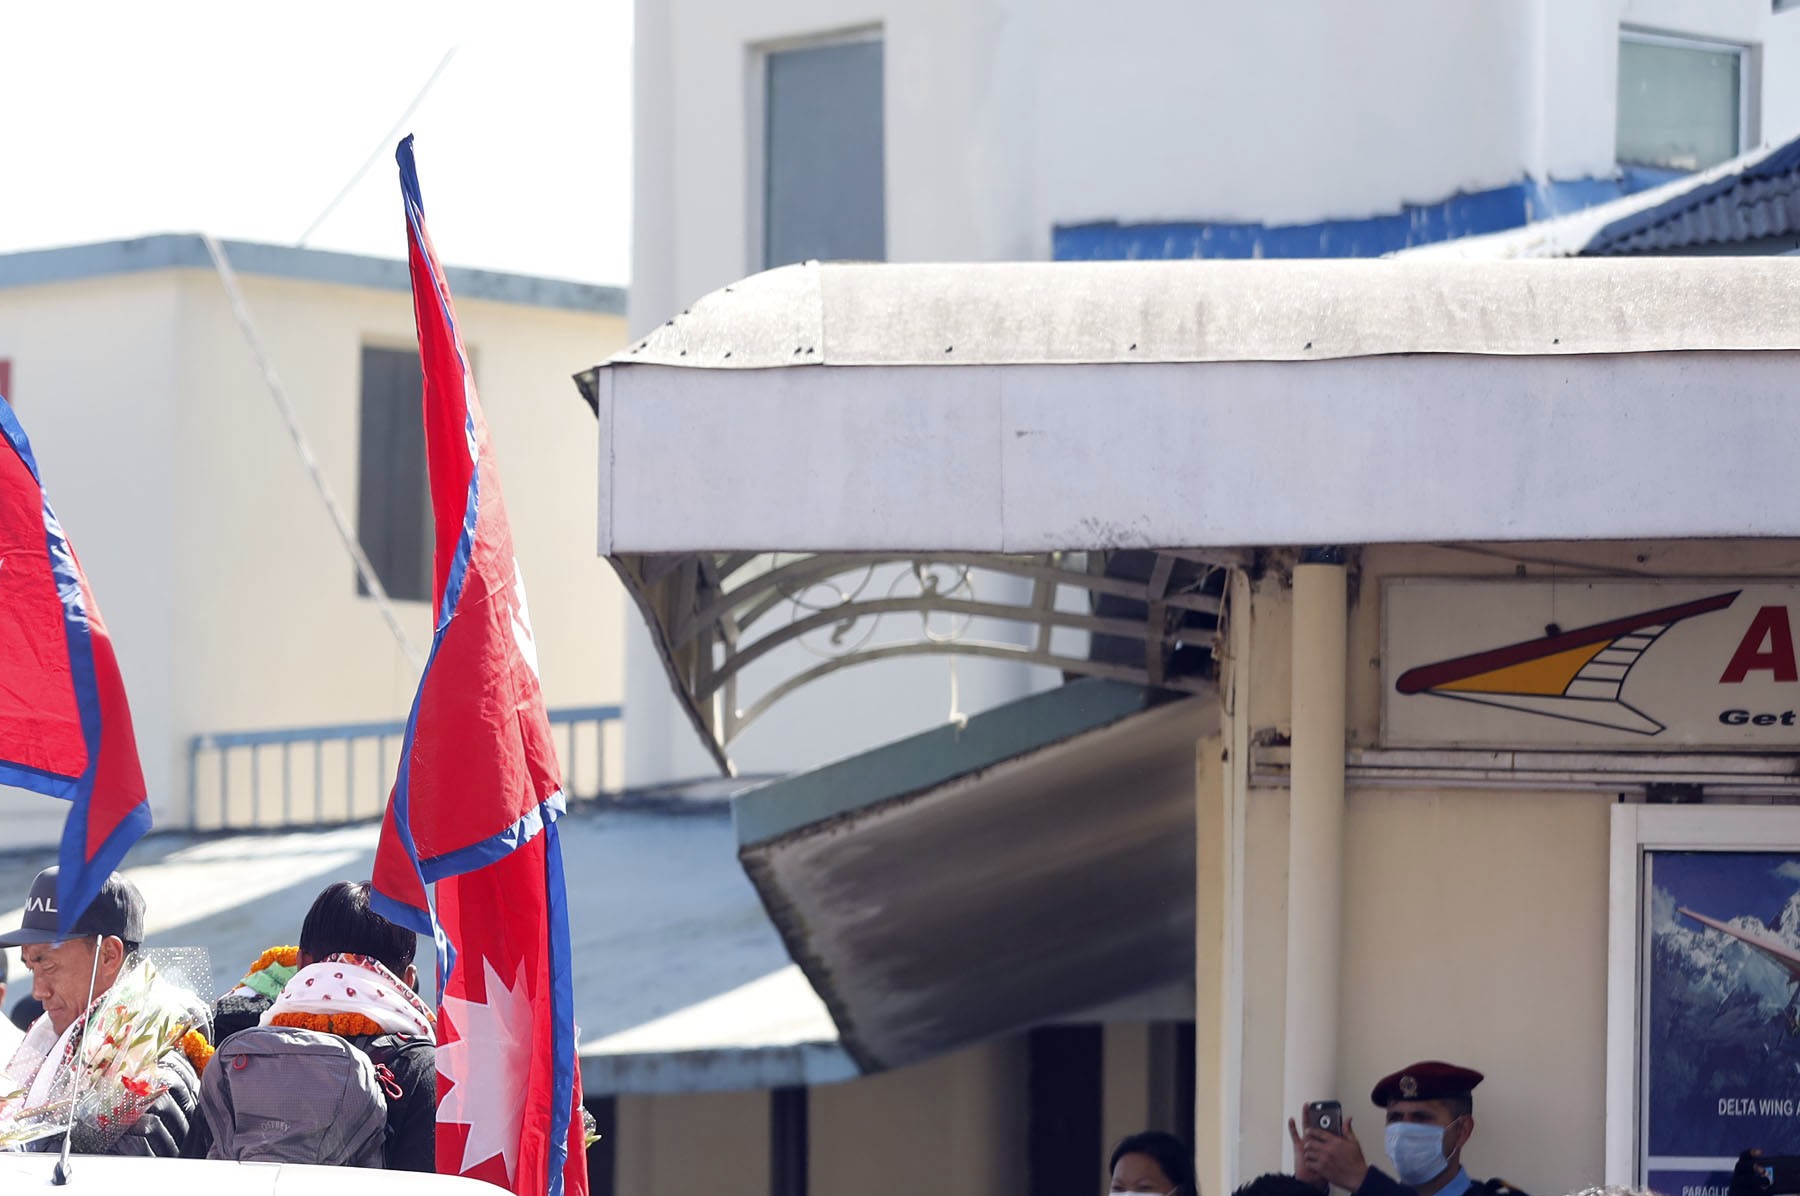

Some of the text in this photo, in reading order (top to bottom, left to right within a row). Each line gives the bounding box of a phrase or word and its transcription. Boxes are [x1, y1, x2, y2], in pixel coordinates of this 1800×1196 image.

[1718, 709, 1797, 726] Get
[1717, 1098, 1757, 1117] DELTA
[1759, 1097, 1793, 1117] WING
